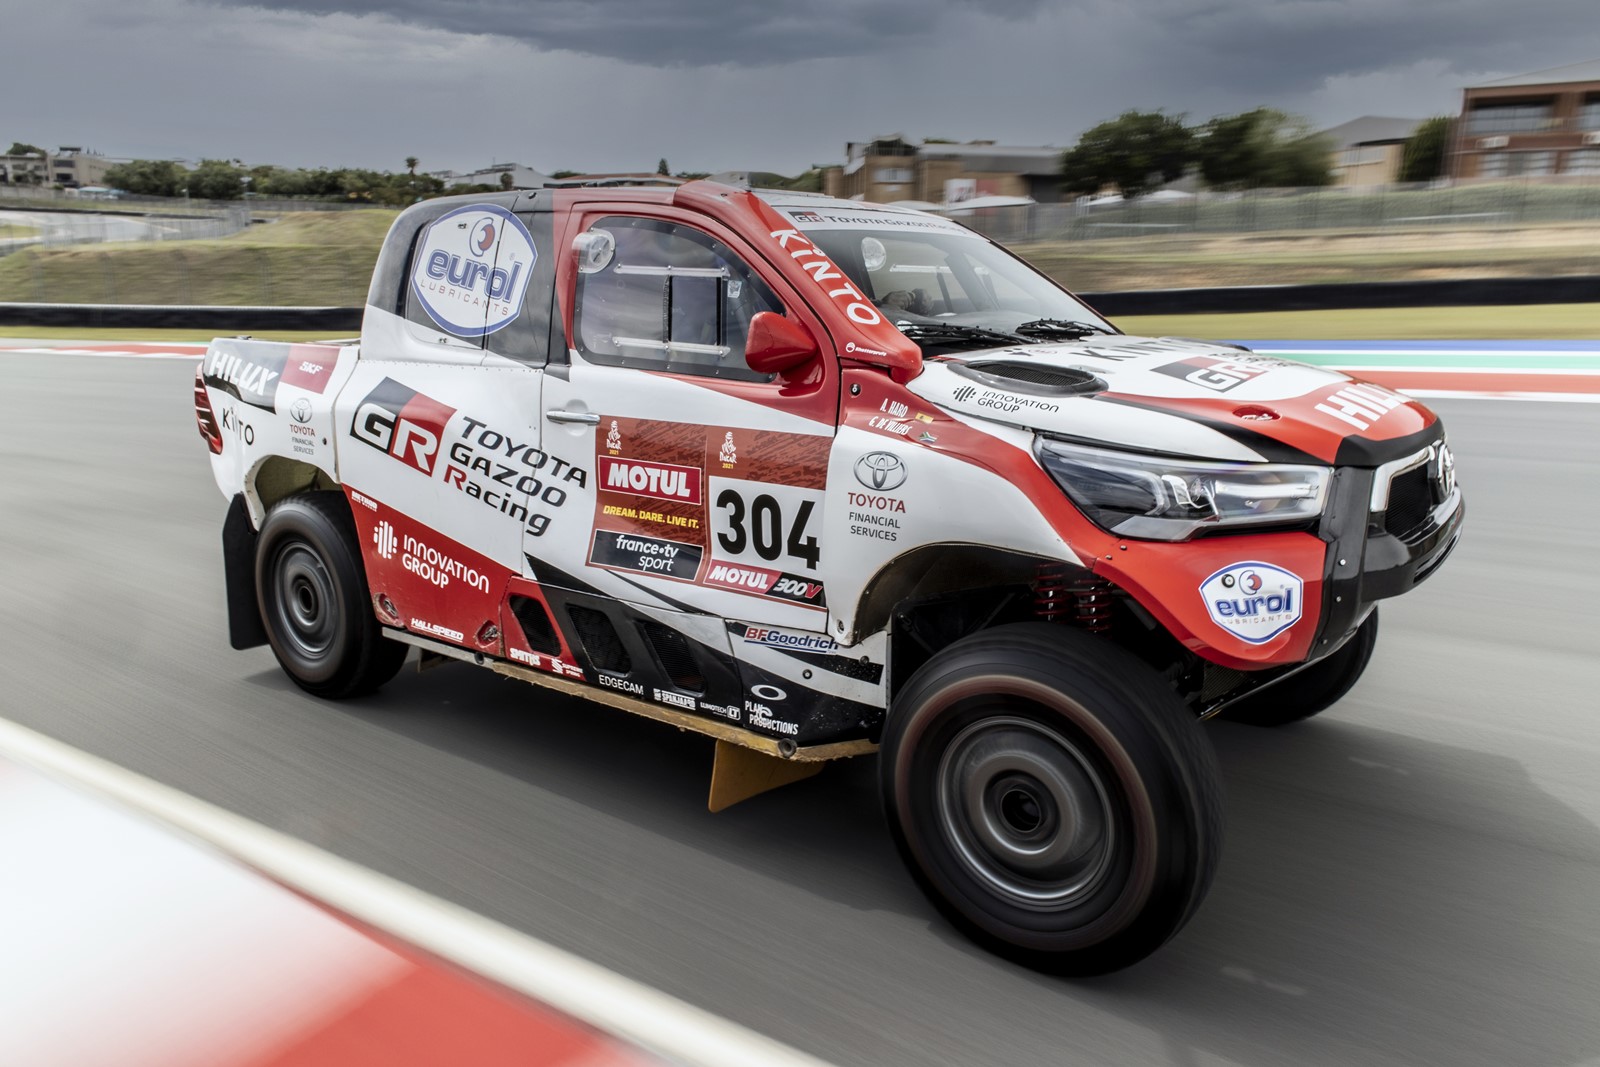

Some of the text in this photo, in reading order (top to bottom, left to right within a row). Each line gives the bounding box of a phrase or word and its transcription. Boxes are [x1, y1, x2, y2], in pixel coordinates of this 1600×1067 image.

[824, 215, 884, 225] TOYOTA
[426, 249, 522, 303] eurol
[419, 279, 509, 316] LUBRICANTS
[208, 350, 279, 396] HILUX
[299, 360, 323, 375] SKF
[887, 400, 909, 418] HARO
[977, 397, 1021, 413] GROUP
[982, 390, 1060, 413] INNOVATION
[289, 424, 316, 437] TOYOTA
[291, 437, 315, 447] FINANCIAL
[353, 402, 438, 473] GR
[293, 445, 315, 456] SERVICES
[461, 416, 588, 490] TOYOTA
[450, 442, 567, 508] GAZOO
[607, 462, 691, 498] MOTUL
[443, 464, 552, 537] Racing
[847, 492, 906, 514] TOYOTA
[603, 505, 700, 529] DREAM. DARE. LIVE IT.
[848, 511, 901, 529] FINANCIAL
[716, 489, 820, 570] 304
[850, 525, 897, 542] SERVICES
[402, 553, 449, 589] GROUP
[403, 534, 490, 594] INNOVATION
[638, 555, 674, 572] sport
[709, 565, 823, 599] MOTUL 300V
[1215, 587, 1293, 618] eurol
[411, 617, 464, 641] HALLSPEED
[1221, 613, 1292, 625] LUBRICANTS
[745, 627, 838, 650] BFGoodrich
[598, 674, 644, 695] EDGECAM
